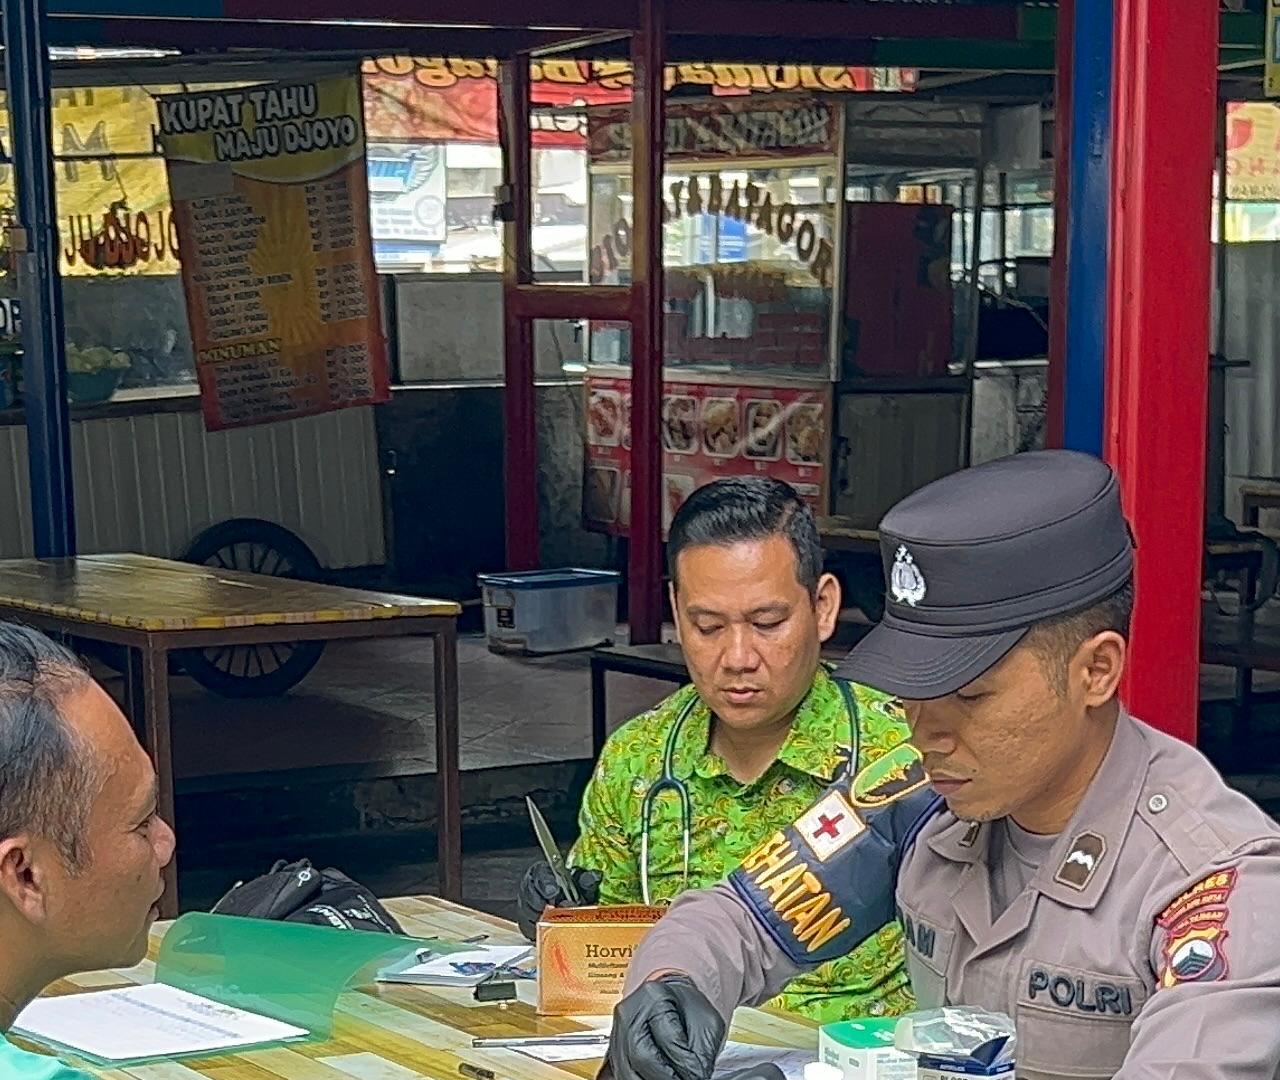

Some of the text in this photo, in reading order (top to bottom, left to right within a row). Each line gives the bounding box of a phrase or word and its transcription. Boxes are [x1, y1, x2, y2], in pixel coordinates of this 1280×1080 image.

[161, 83, 317, 133] KUPAT TAHU
[214, 115, 357, 162] MAJU DJOYO
[1027, 969, 1133, 1017] POLRI
